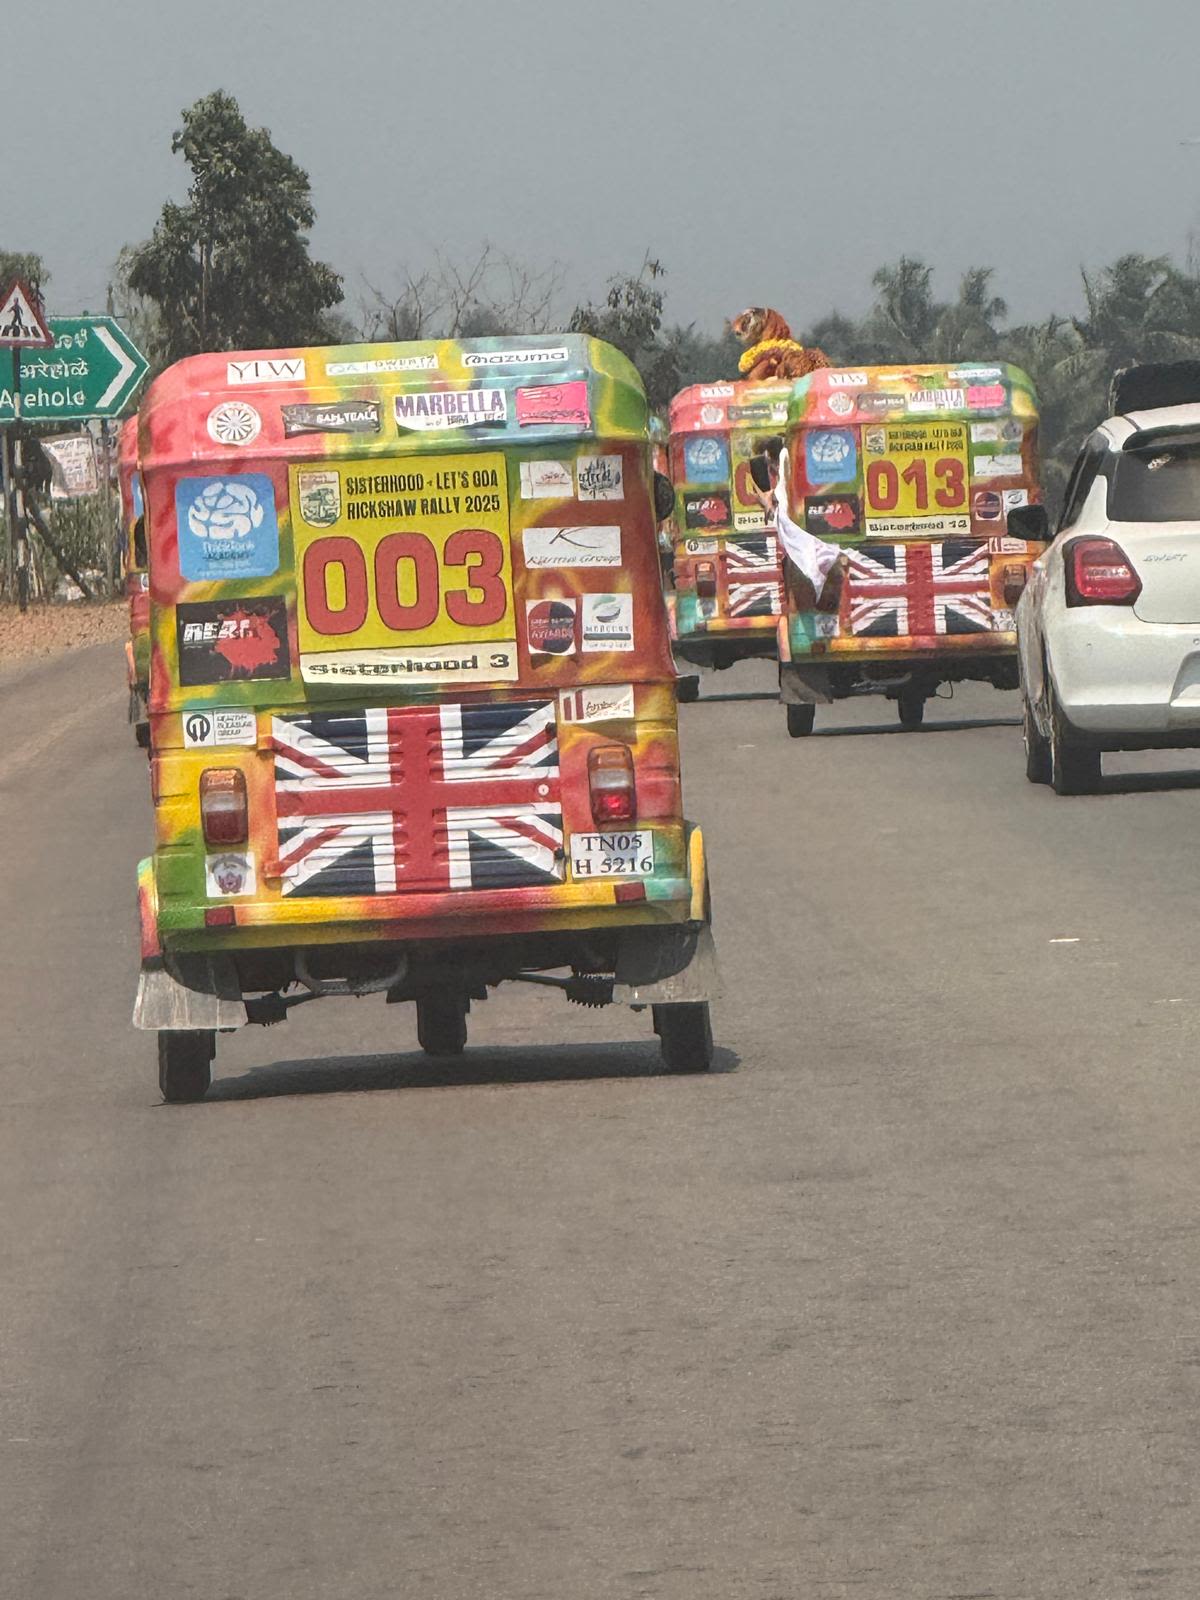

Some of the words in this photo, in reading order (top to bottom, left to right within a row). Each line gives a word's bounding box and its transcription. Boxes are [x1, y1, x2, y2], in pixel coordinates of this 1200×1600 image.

[230, 359, 302, 380] YIW
[0, 386, 85, 409] Aehole
[395, 390, 505, 419] MARBELLA
[346, 473, 424, 496] SISTERHOOD
[435, 470, 469, 491] LET'S
[472, 469, 499, 488] GOA
[866, 457, 966, 511] 013
[347, 498, 417, 521] RICKSHAW
[420, 497, 461, 516] RALLY
[464, 494, 501, 514] 2025
[302, 528, 508, 636] 003
[307, 655, 478, 676] Sisterhood
[489, 653, 510, 669] 3
[581, 833, 643, 852] TN05
[575, 859, 592, 874] H
[601, 855, 653, 873] 5216
